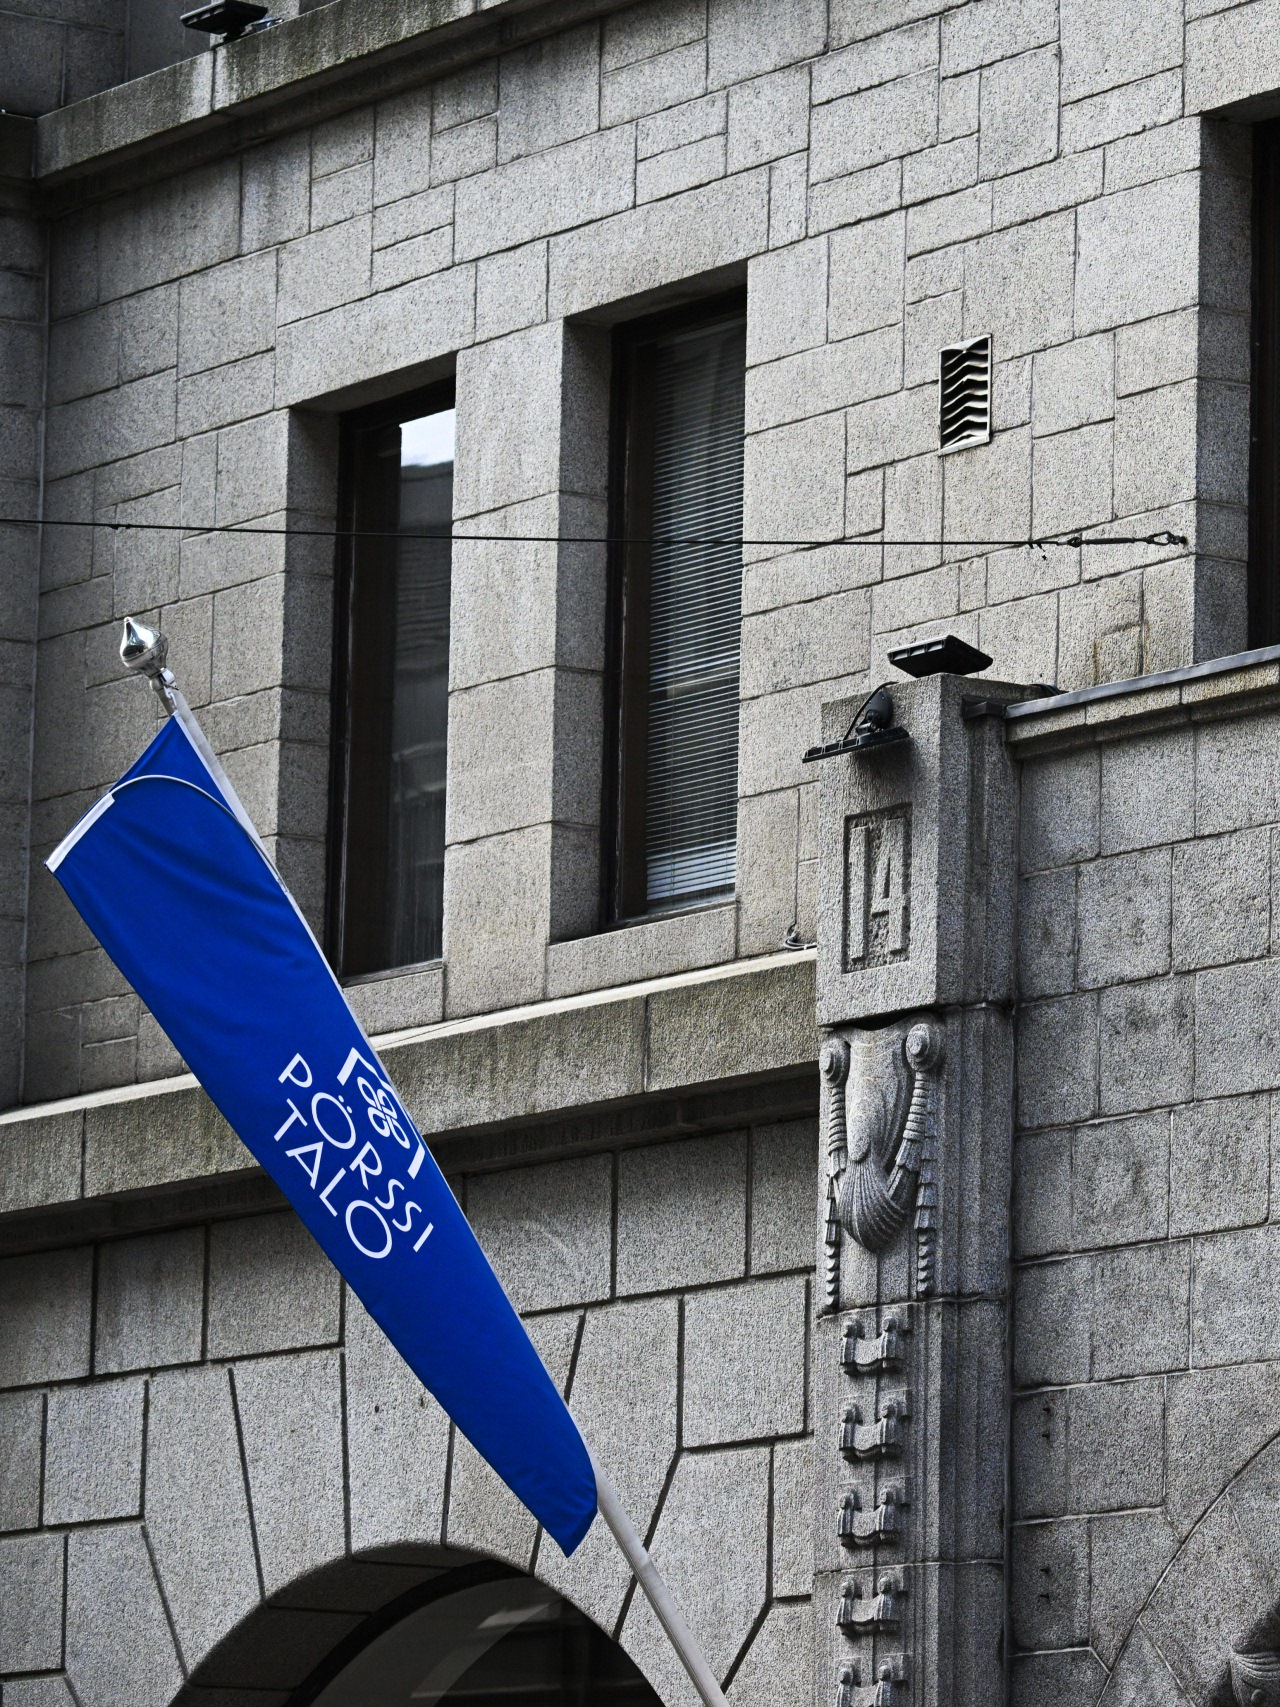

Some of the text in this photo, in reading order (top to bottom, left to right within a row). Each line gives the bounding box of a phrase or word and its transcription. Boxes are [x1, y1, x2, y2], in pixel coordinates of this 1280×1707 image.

[848, 818, 908, 958] 14
[273, 1098, 393, 1259] TALO
[277, 1052, 434, 1253] PÖRSSI
